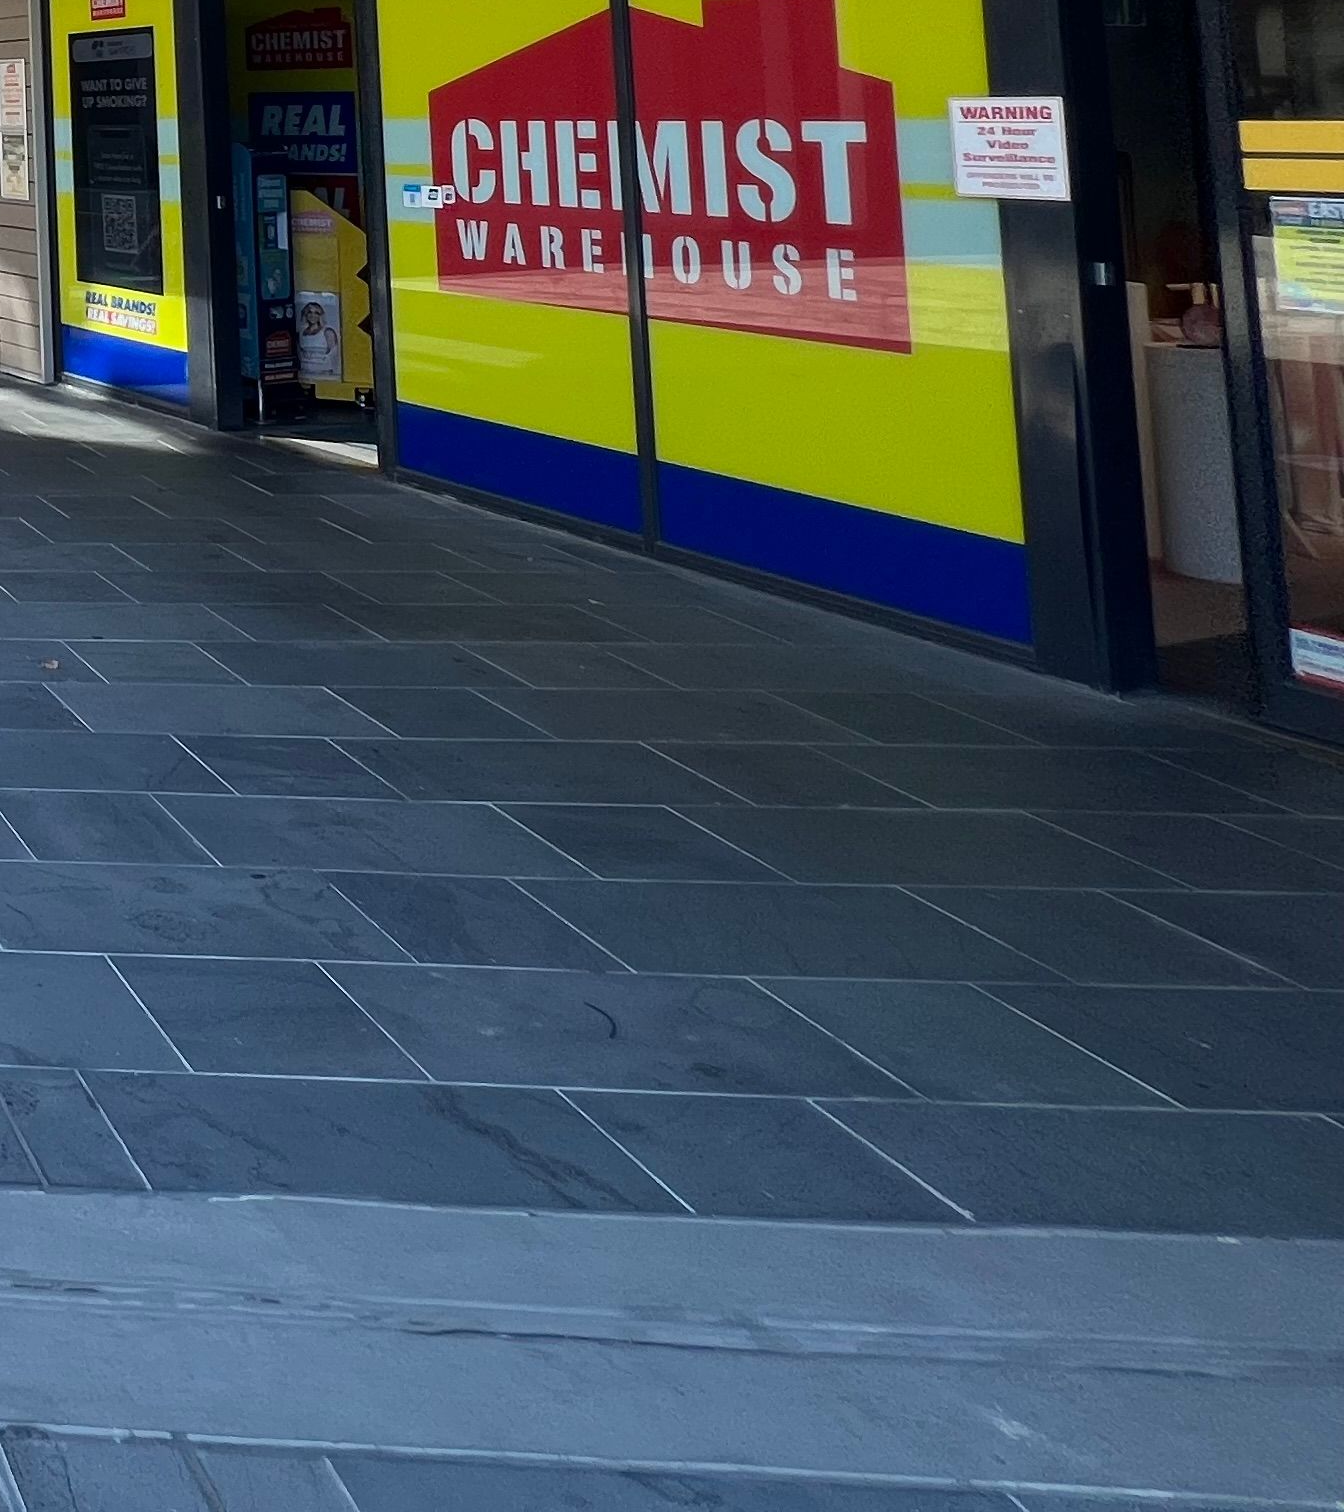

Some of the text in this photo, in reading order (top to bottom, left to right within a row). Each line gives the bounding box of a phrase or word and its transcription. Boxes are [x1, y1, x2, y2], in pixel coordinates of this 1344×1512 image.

[250, 29, 347, 51] CHEMIST
[261, 103, 347, 137] REAL
[960, 106, 1052, 120] WARNING
[977, 127, 995, 136] 24
[986, 139, 1030, 150] Video
[962, 152, 1056, 164] Surveillance
[451, 118, 868, 226] CHEMIST
[85, 291, 156, 317] REAL BRANDS!
[87, 307, 110, 322] REAL
